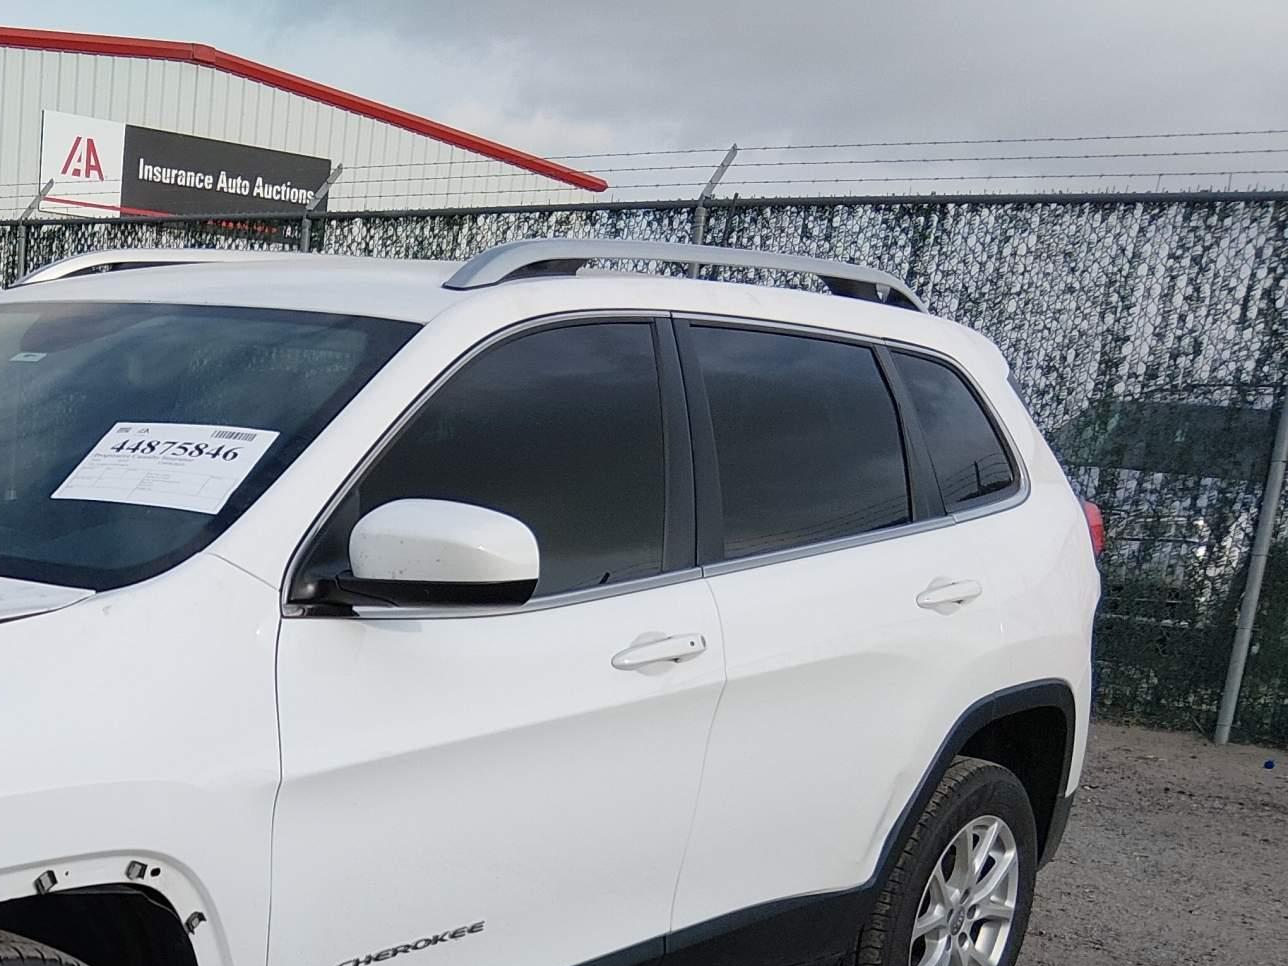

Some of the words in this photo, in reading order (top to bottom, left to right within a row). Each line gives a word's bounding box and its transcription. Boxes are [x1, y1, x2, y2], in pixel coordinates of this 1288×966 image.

[138, 158, 213, 190] Insurance
[216, 171, 250, 195] Auto
[253, 177, 314, 205] Auctions
[110, 439, 244, 462] 44875846
